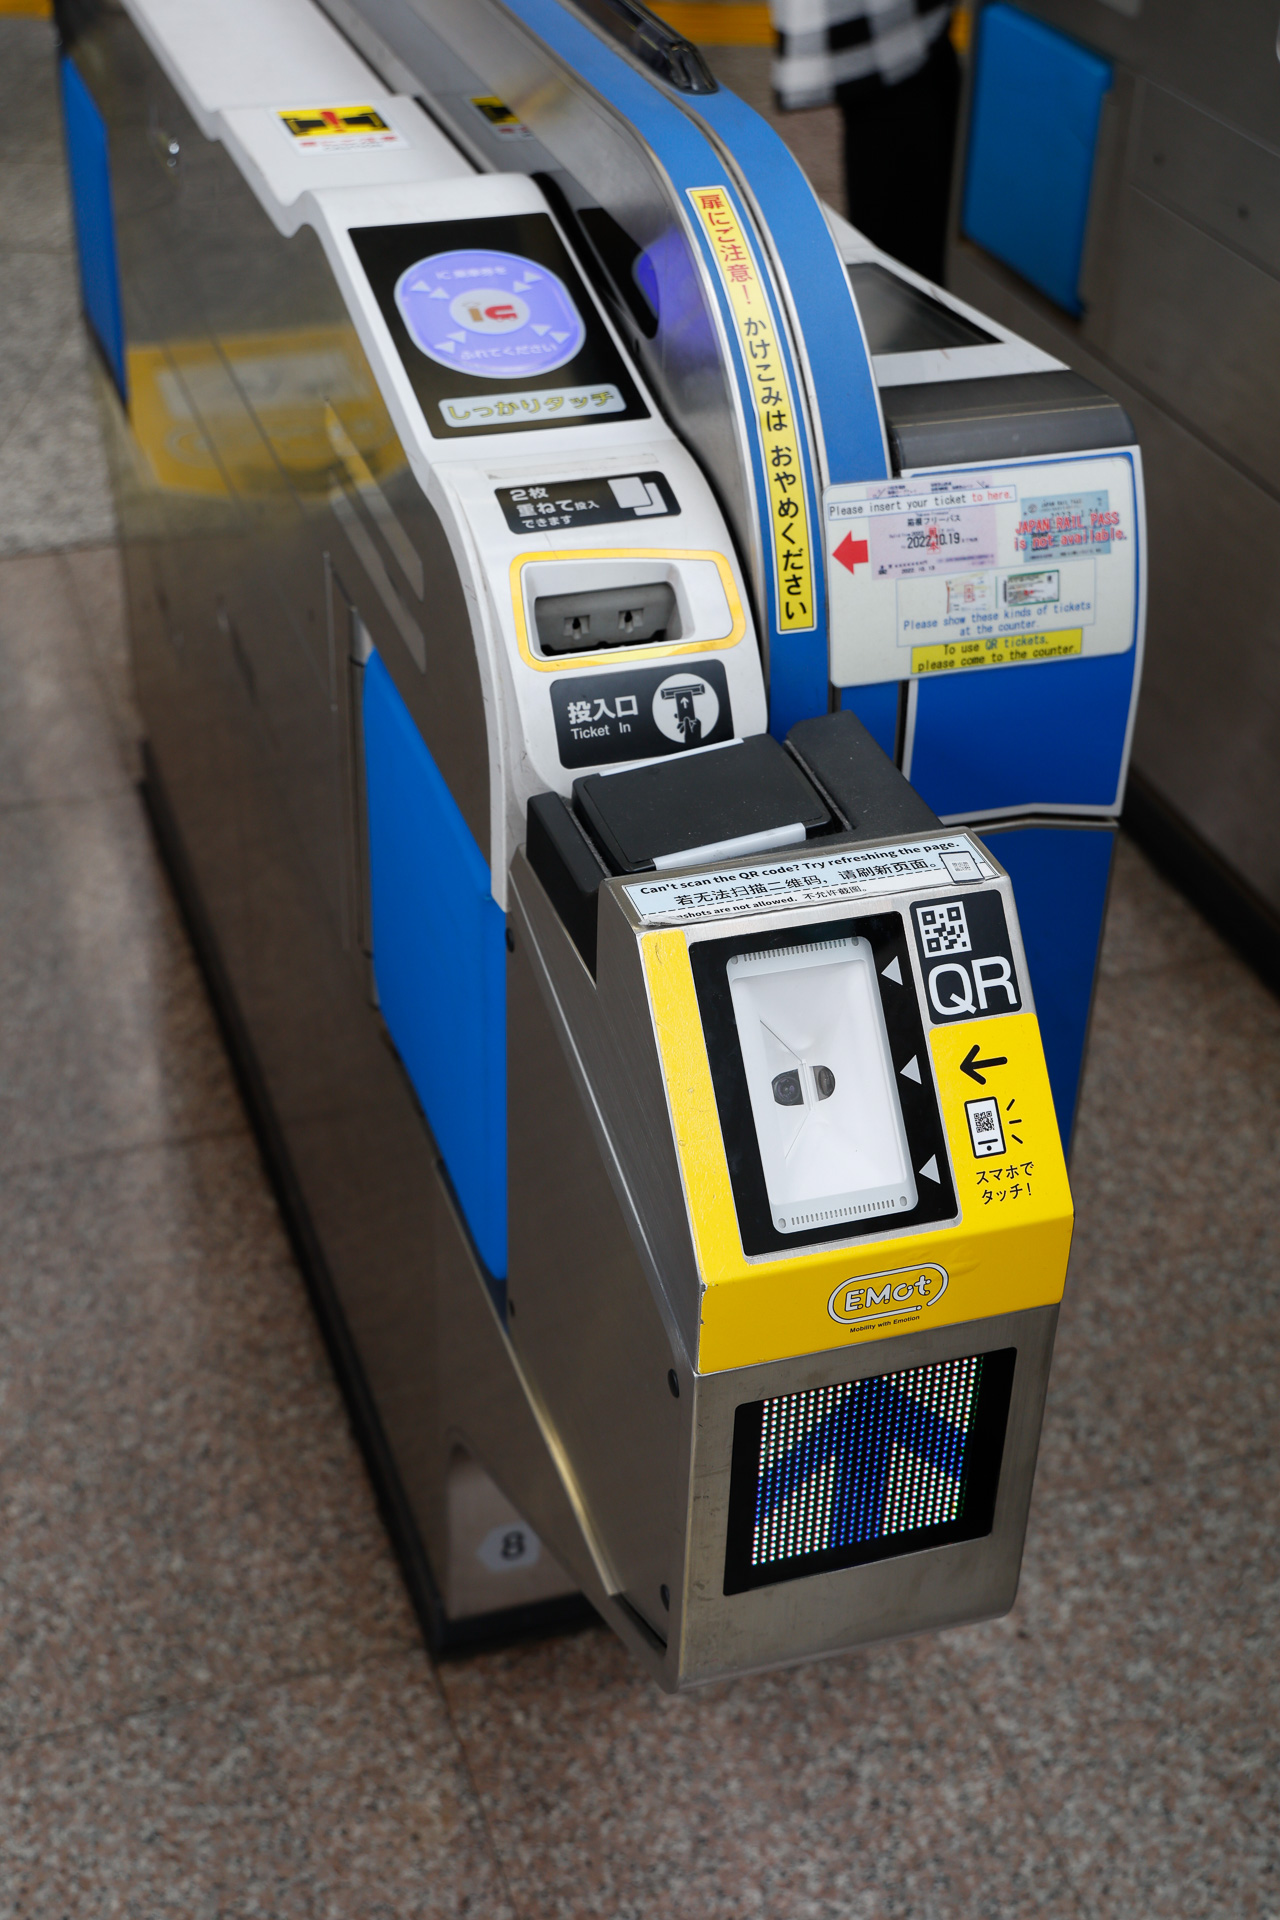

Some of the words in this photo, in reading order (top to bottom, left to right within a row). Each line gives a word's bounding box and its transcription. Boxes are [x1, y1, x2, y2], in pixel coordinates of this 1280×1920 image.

[447, 390, 614, 421] しっかりタッチ
[697, 194, 753, 305] 扉にご注意！
[744, 316, 788, 432] かけこみは
[771, 445, 808, 620] おやめください
[509, 486, 549, 502] 2枚
[829, 503, 864, 517] Please
[869, 501, 902, 513] insert
[906, 498, 928, 510] your
[934, 494, 967, 507] ticket
[972, 492, 984, 503] to
[987, 490, 1013, 501] here.
[521, 515, 573, 529] できます
[1015, 517, 1051, 535] JAPAN
[1056, 515, 1085, 530] RAIL
[1090, 511, 1120, 527] PASS
[1014, 537, 1027, 552] is
[1032, 534, 1054, 548] not
[1060, 527, 1128, 546] available.
[903, 618, 938, 630] Please
[943, 616, 966, 626] show
[971, 611, 999, 624] these
[1003, 607, 1032, 619] kinds
[1036, 604, 1048, 615] of
[1053, 601, 1092, 614] tickets
[959, 626, 971, 637] at
[976, 623, 993, 634] the
[998, 620, 1040, 632] counter.
[917, 656, 955, 672] please
[960, 655, 985, 667] come
[992, 653, 1004, 663] to
[1009, 649, 1028, 661] the
[1032, 644, 1078, 658] counter.
[943, 643, 957, 656] To
[961, 643, 980, 653] use
[985, 638, 998, 651] QR
[566, 694, 640, 726] 投入口
[570, 723, 611, 741] Ticket
[618, 721, 632, 734] In
[640, 880, 679, 895] Can't
[680, 877, 711, 890] scan
[712, 872, 737, 885] the
[738, 870, 760, 881] QR
[761, 862, 800, 876] code?
[801, 860, 826, 870] Try
[827, 849, 898, 866] refreshing
[898, 846, 921, 856] the
[922, 840, 960, 853] page.
[714, 906, 731, 916] are
[732, 903, 751, 913] not
[752, 895, 798, 908] allowed.
[928, 955, 1018, 1016] QR
[975, 1160, 1035, 1186] スマホで
[849, 1323, 876, 1333] Mobility
[877, 1320, 892, 1328] with
[893, 1314, 920, 1324] Emotion
[501, 1531, 526, 1561] 8
